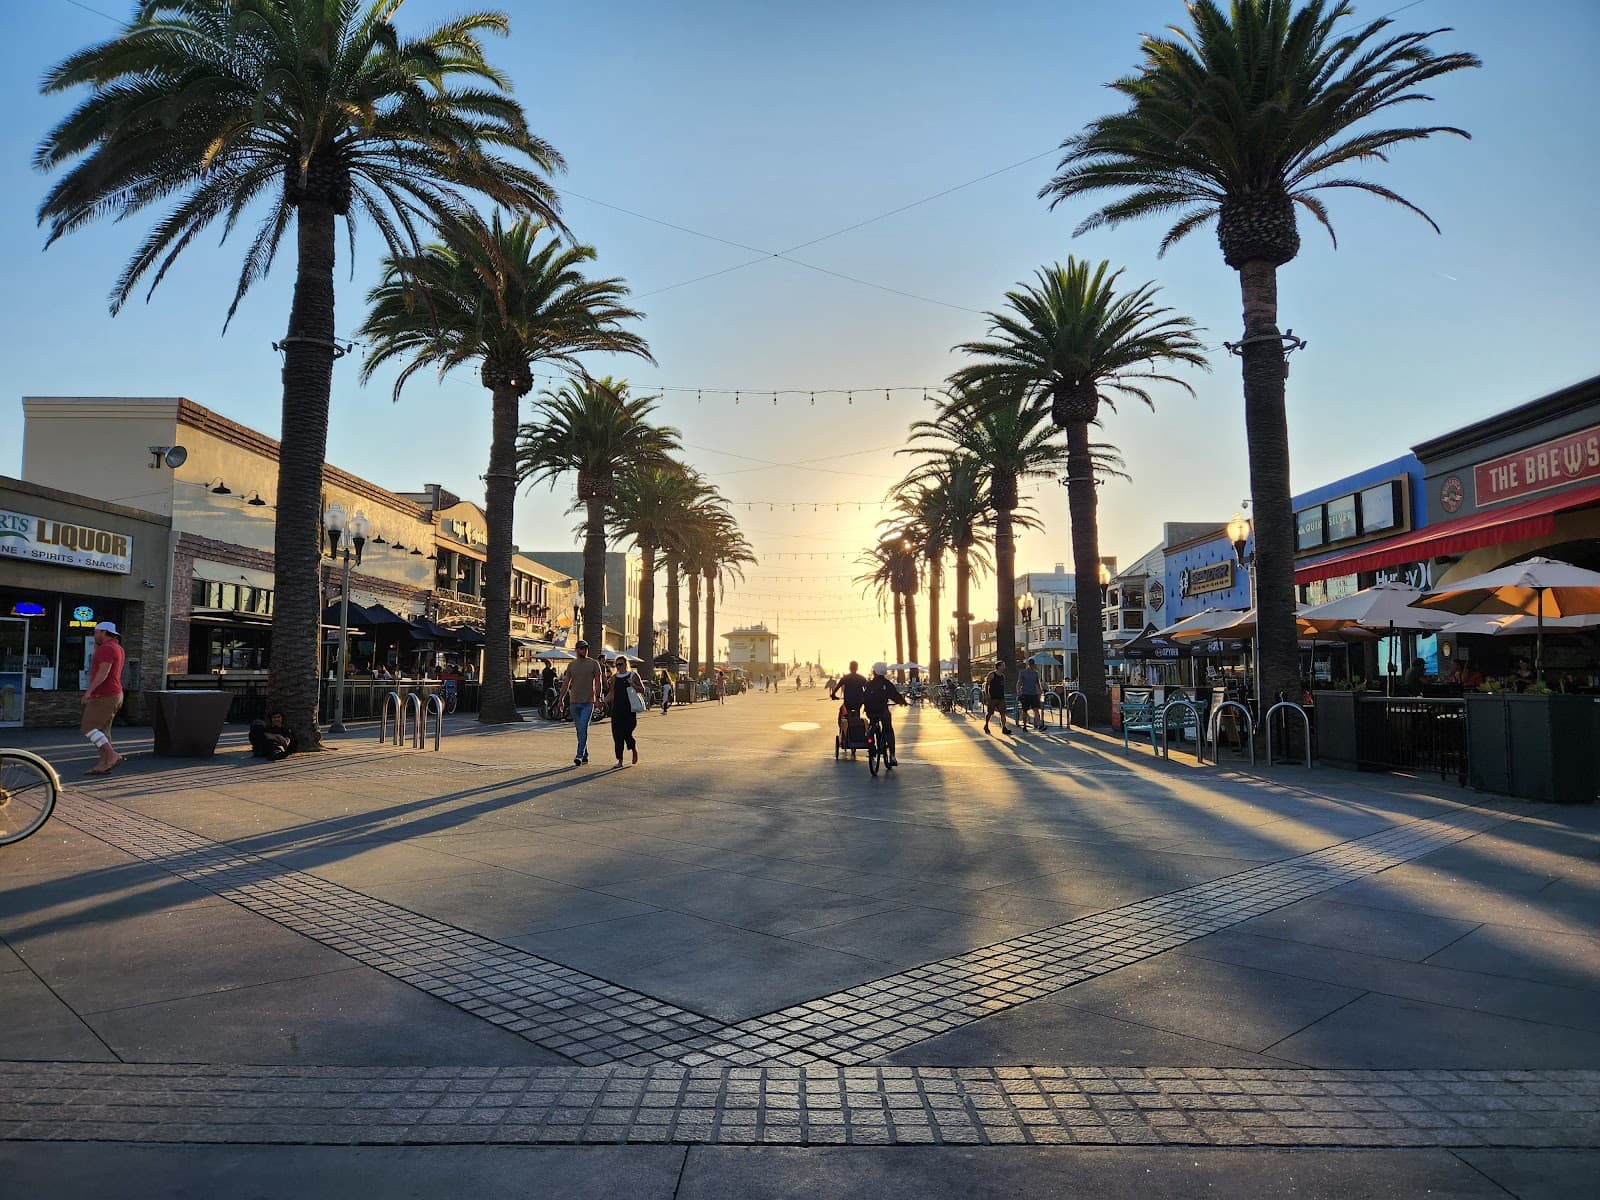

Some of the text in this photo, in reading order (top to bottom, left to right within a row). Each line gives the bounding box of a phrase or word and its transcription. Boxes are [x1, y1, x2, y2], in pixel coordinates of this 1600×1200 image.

[1489, 437, 1600, 493] THE BREWS
[36, 519, 127, 557] LIQUOR
[31, 550, 74, 563] SPIRITS
[85, 558, 126, 571] SNACKS
